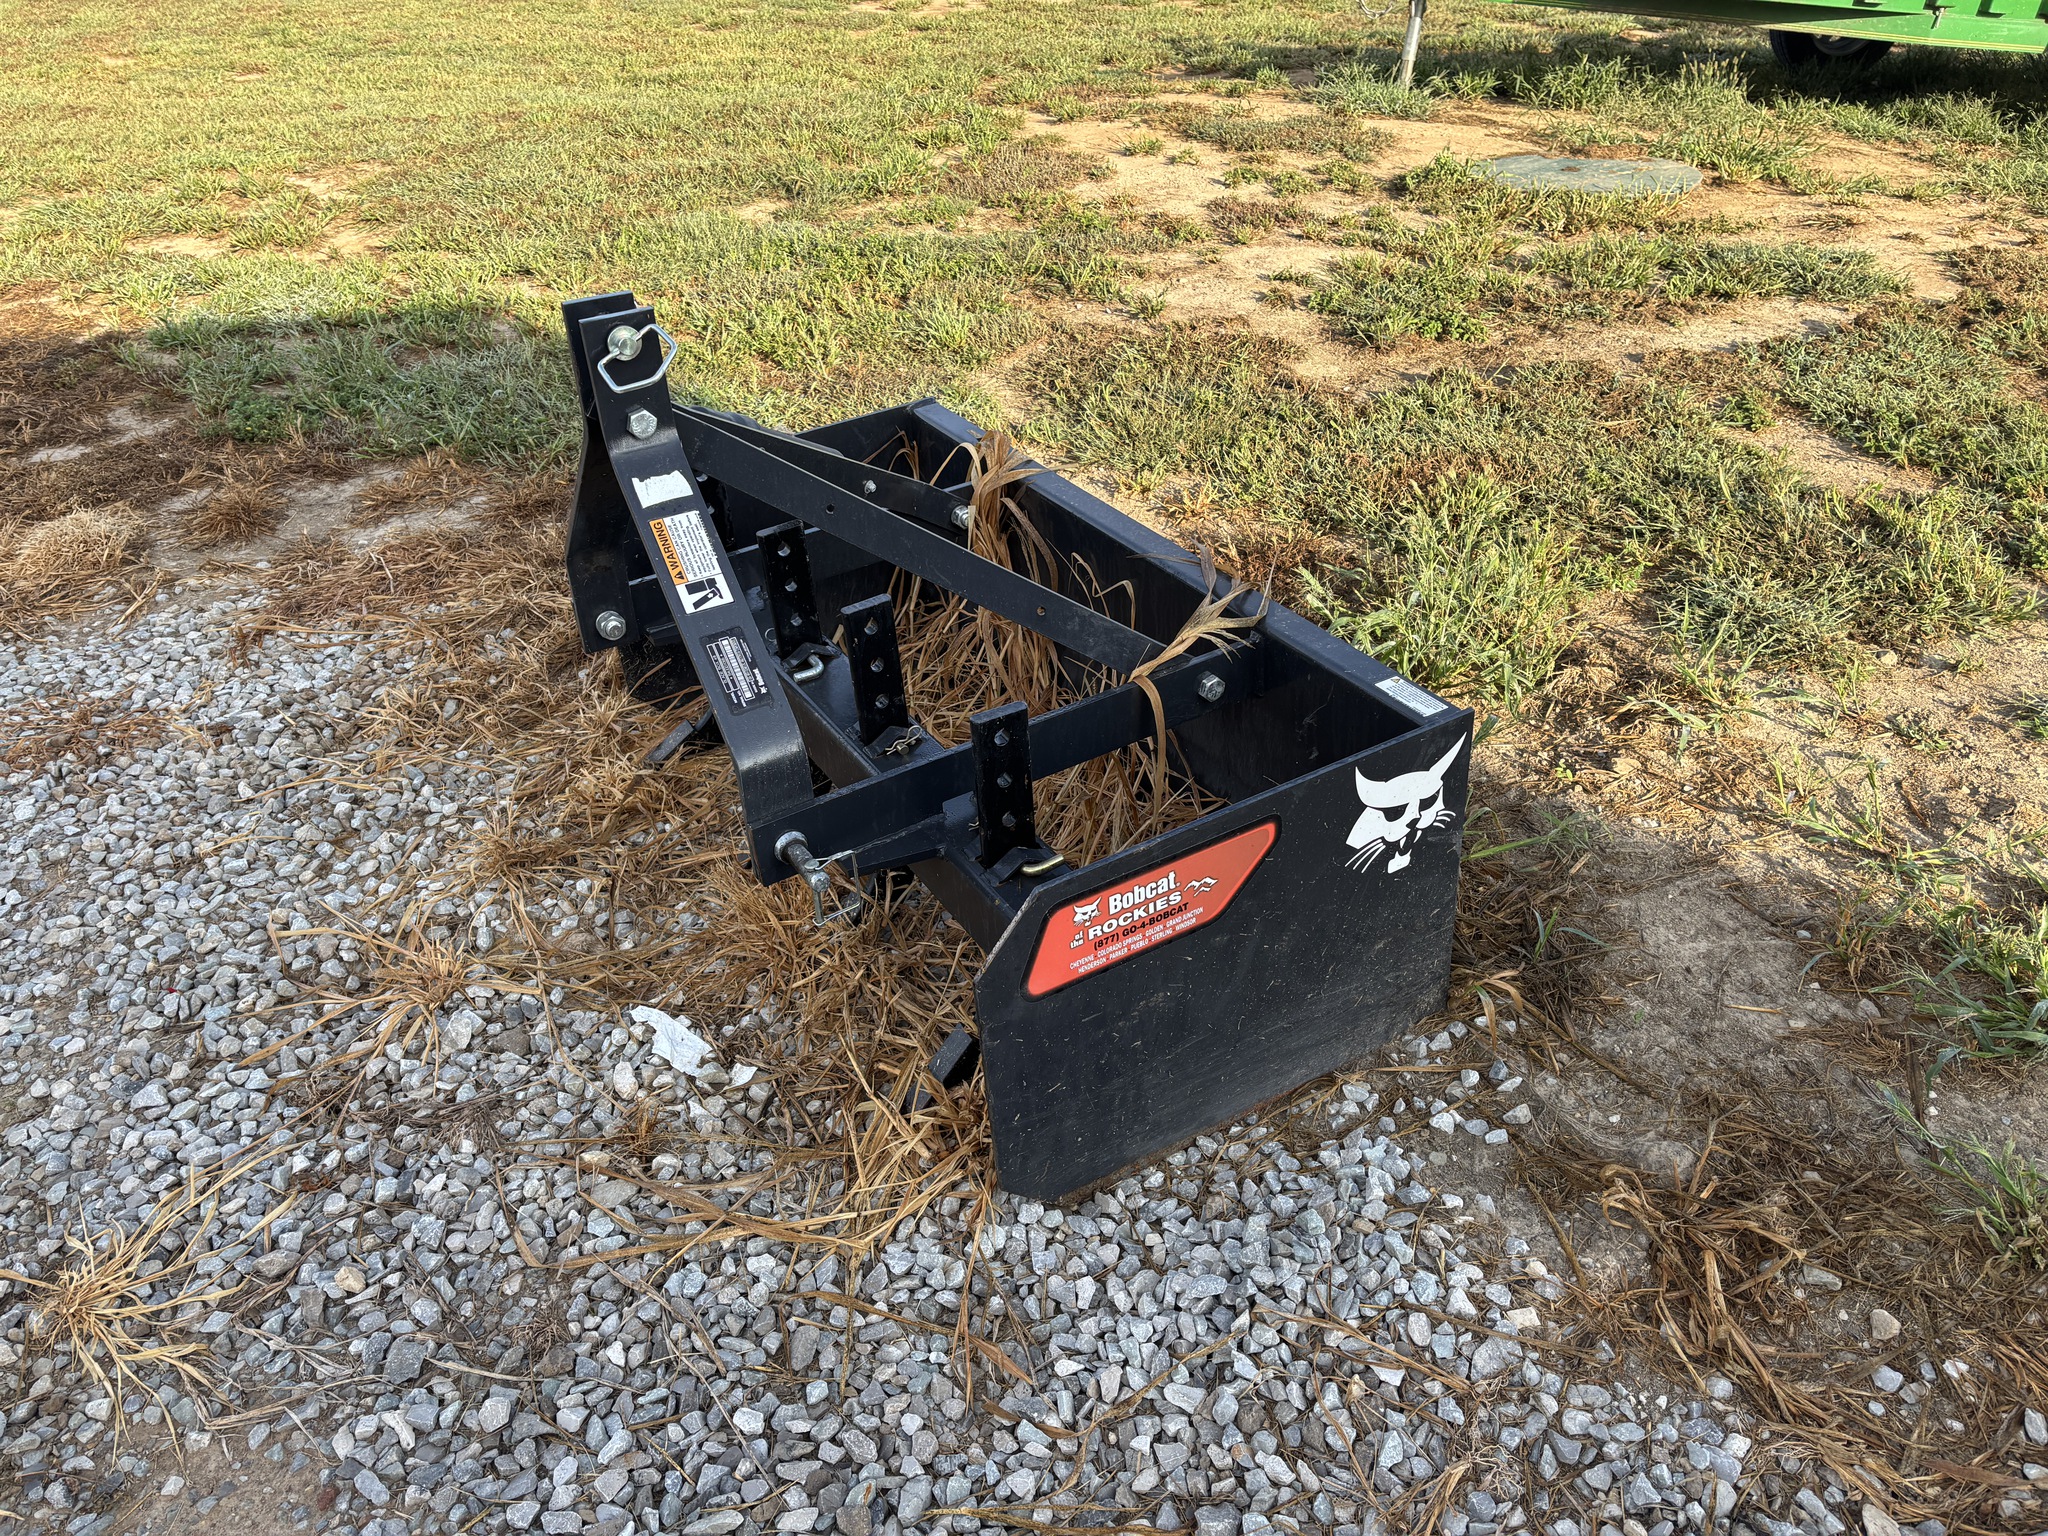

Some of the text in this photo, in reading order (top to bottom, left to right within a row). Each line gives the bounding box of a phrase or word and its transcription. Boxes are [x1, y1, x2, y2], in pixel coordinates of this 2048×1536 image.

[669, 524, 677, 540] CAUSE
[670, 517, 679, 532] DEATH
[654, 521, 679, 570] WARNING
[681, 540, 689, 557] INJURY
[687, 557, 697, 577] SERIOUS
[1108, 870, 1179, 915] Bobcat
[1088, 892, 1182, 940] ROCKIES
[1093, 902, 1189, 951] (877) GO-4-BOBCAT
[1069, 906, 1204, 970] CHEYENNE COLORADO SPRINGS GOLDEN GRAND JUNCTION
[1070, 938, 1084, 949] the
[1074, 930, 1085, 941] of
[1077, 917, 1197, 974] HENDERSON PARKER PUEBLO STERLING WINDSOR
